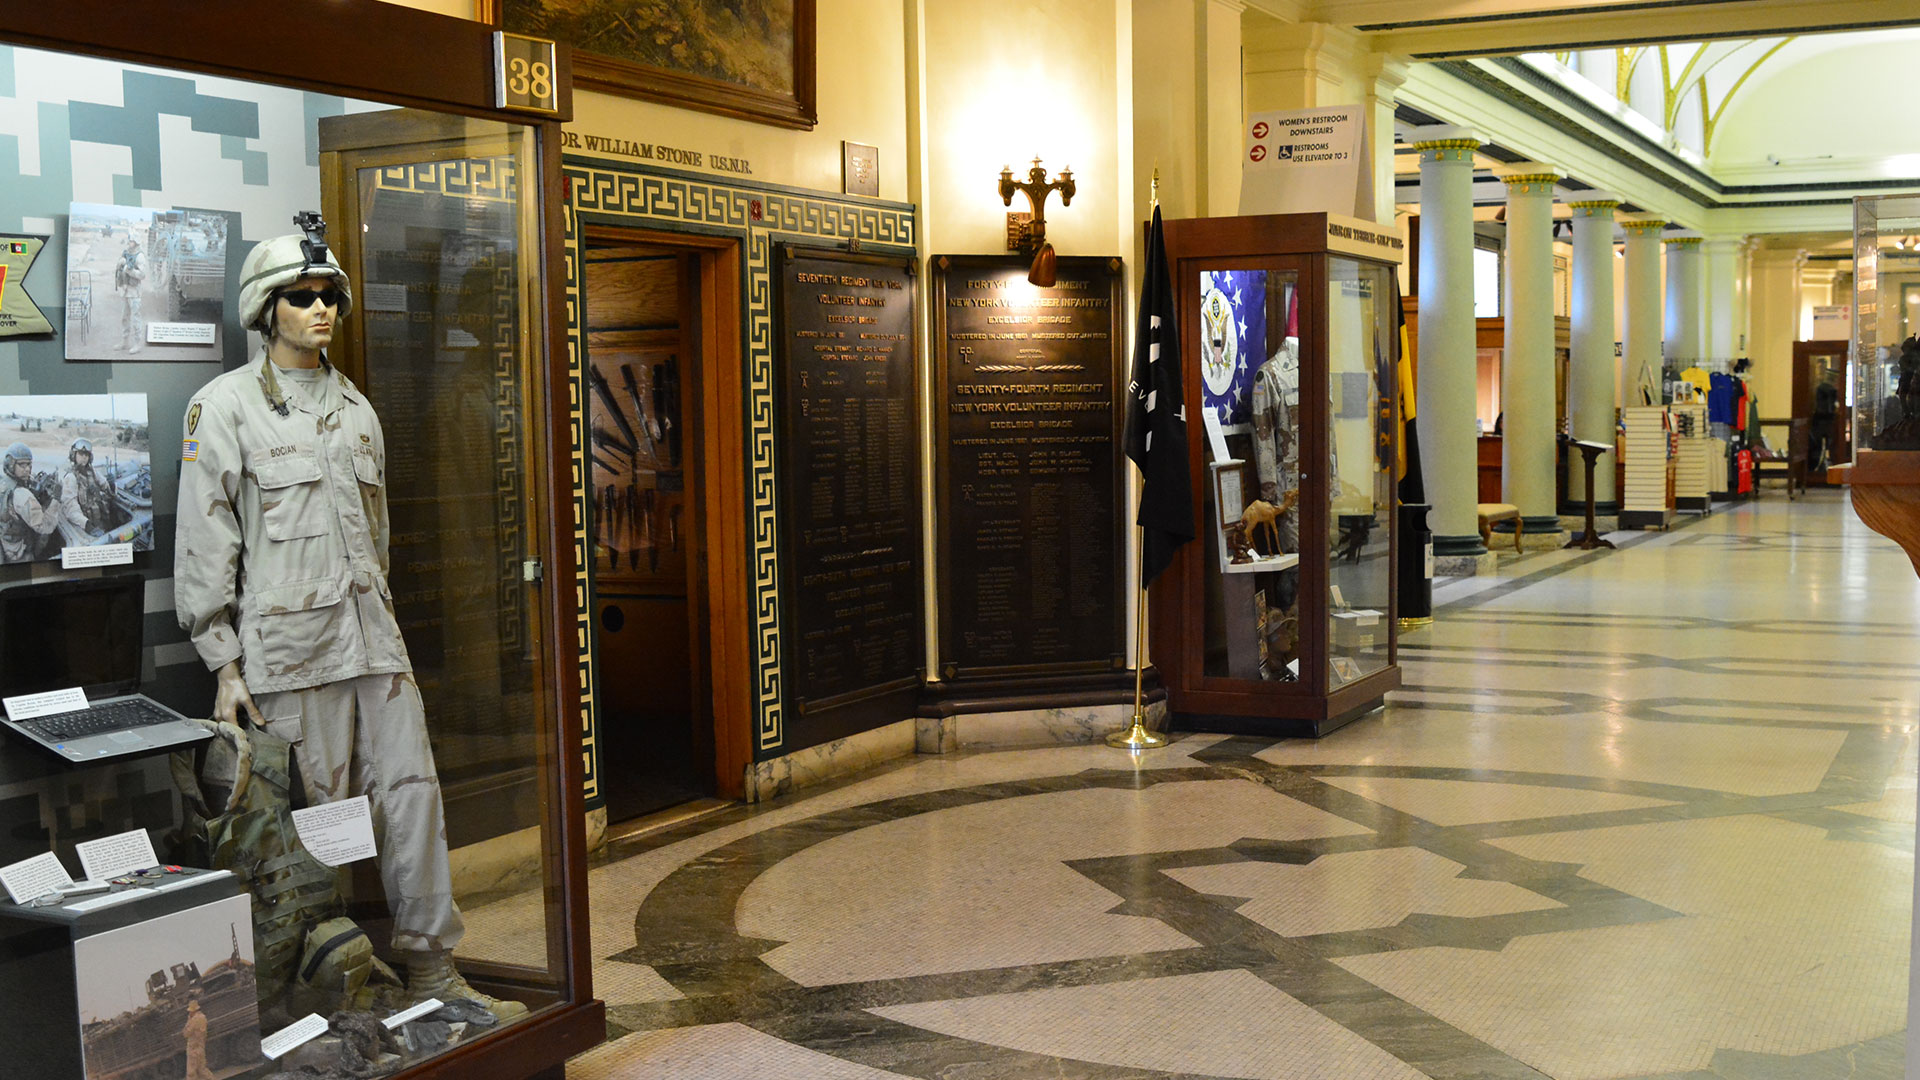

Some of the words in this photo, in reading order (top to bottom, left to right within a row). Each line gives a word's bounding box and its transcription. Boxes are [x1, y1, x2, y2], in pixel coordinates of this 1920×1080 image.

[509, 57, 551, 98] 38
[1279, 116, 1311, 127] WOMEN'S
[1312, 114, 1348, 124] RESTROOM
[1289, 126, 1334, 136] DOWNSTAIRS
[584, 135, 654, 159] WILLIAM
[656, 145, 702, 167] STONE
[1293, 142, 1329, 152] RESTROOMS
[1292, 154, 1304, 163] USE
[1305, 152, 1333, 162] ELEVATOR
[1334, 152, 1342, 160] TO
[1343, 152, 1348, 160] 3
[818, 293, 855, 306] VOLUNTEER
[858, 296, 886, 308] INFANTRY
[950, 298, 971, 308] NEW
[972, 298, 998, 308] YORK
[1061, 298, 1109, 308] INFANTRY
[987, 316, 1033, 325] EXCELSIOR
[1037, 316, 1072, 325] BRIGADE
[951, 333, 987, 341] MUSTERED
[996, 333, 1014, 341] JUNE
[960, 346, 974, 355] CO.
[957, 384, 1050, 395] SEVENTY-FOURTH
[1053, 383, 1104, 394] REGIMENT
[951, 402, 972, 413] NEW
[974, 402, 1001, 413] YORK
[1003, 402, 1062, 412] VOLUNTEER
[1063, 401, 1111, 412] INFANTRY
[990, 421, 1034, 430] EXCELSIOR
[1039, 420, 1073, 429] BRIGADE
[953, 438, 988, 446] MUSTERED
[270, 445, 297, 458] BOCIAN
